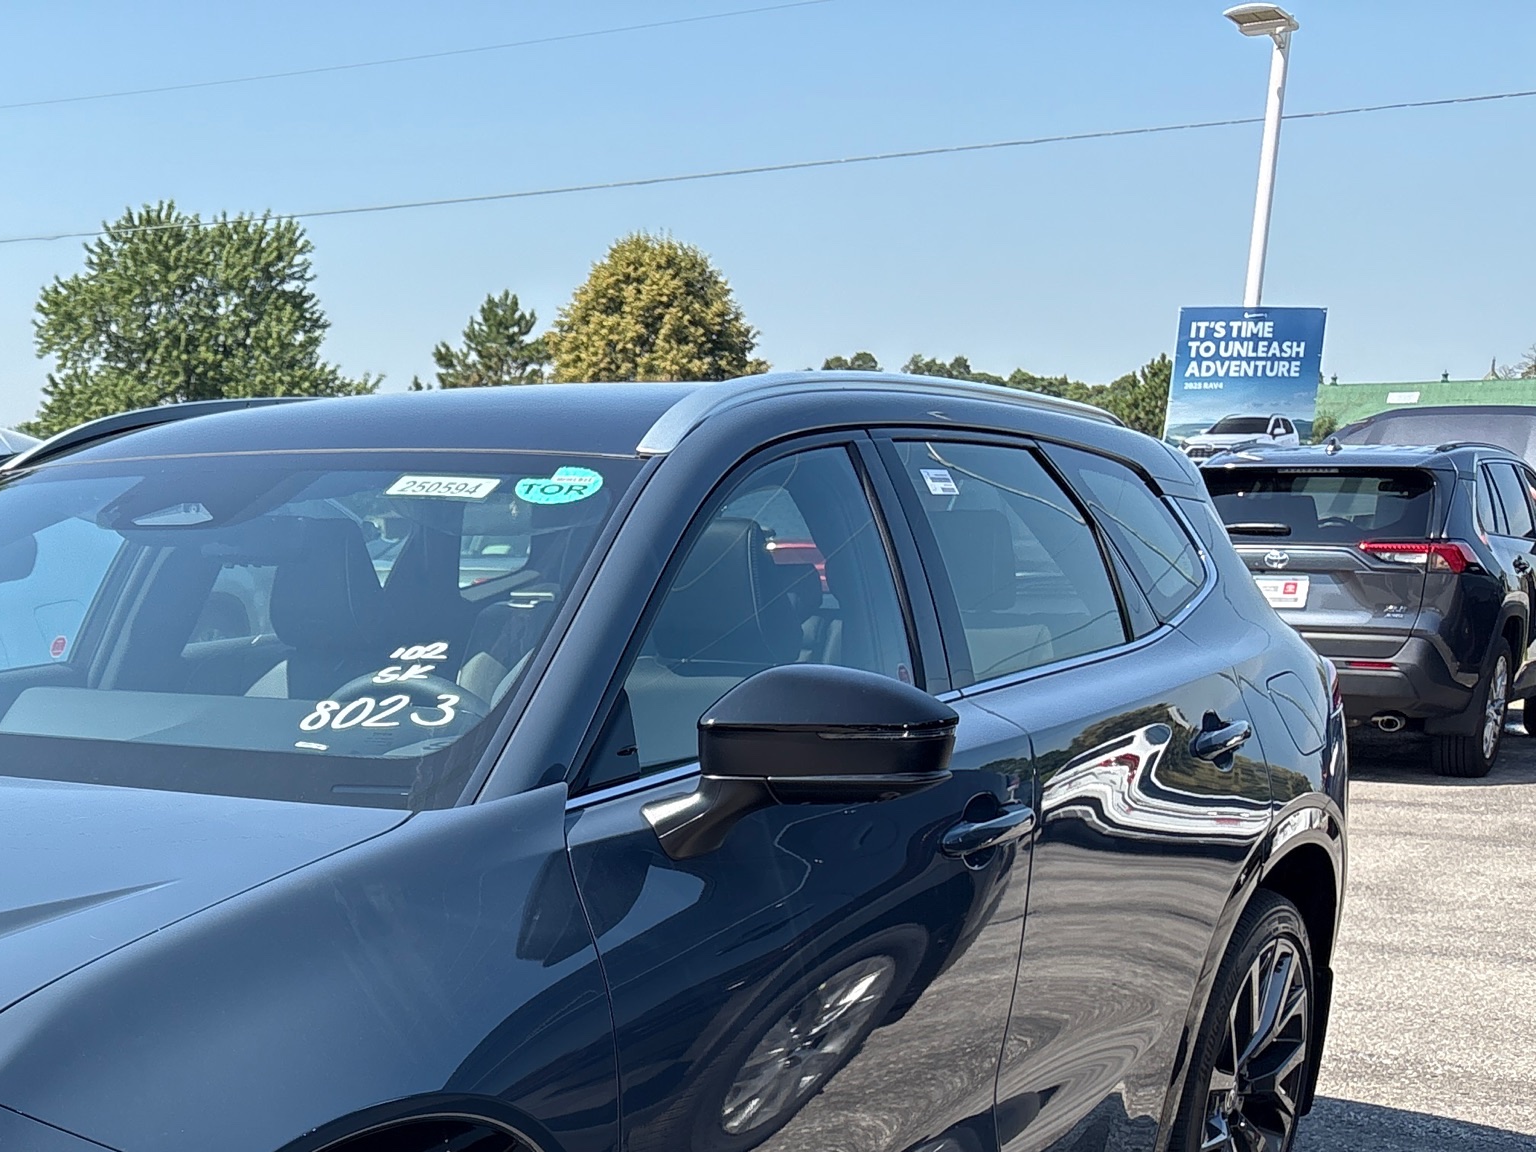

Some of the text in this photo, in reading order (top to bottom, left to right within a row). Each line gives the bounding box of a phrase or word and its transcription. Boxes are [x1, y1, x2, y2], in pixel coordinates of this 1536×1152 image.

[1189, 320, 1274, 339] IT'S TIME
[1187, 340, 1306, 359] TO UNLEASH
[1183, 360, 1301, 378] ADVENTURE
[1203, 382, 1224, 390] RAV4
[396, 479, 483, 496] 250594
[521, 482, 588, 497] TOR
